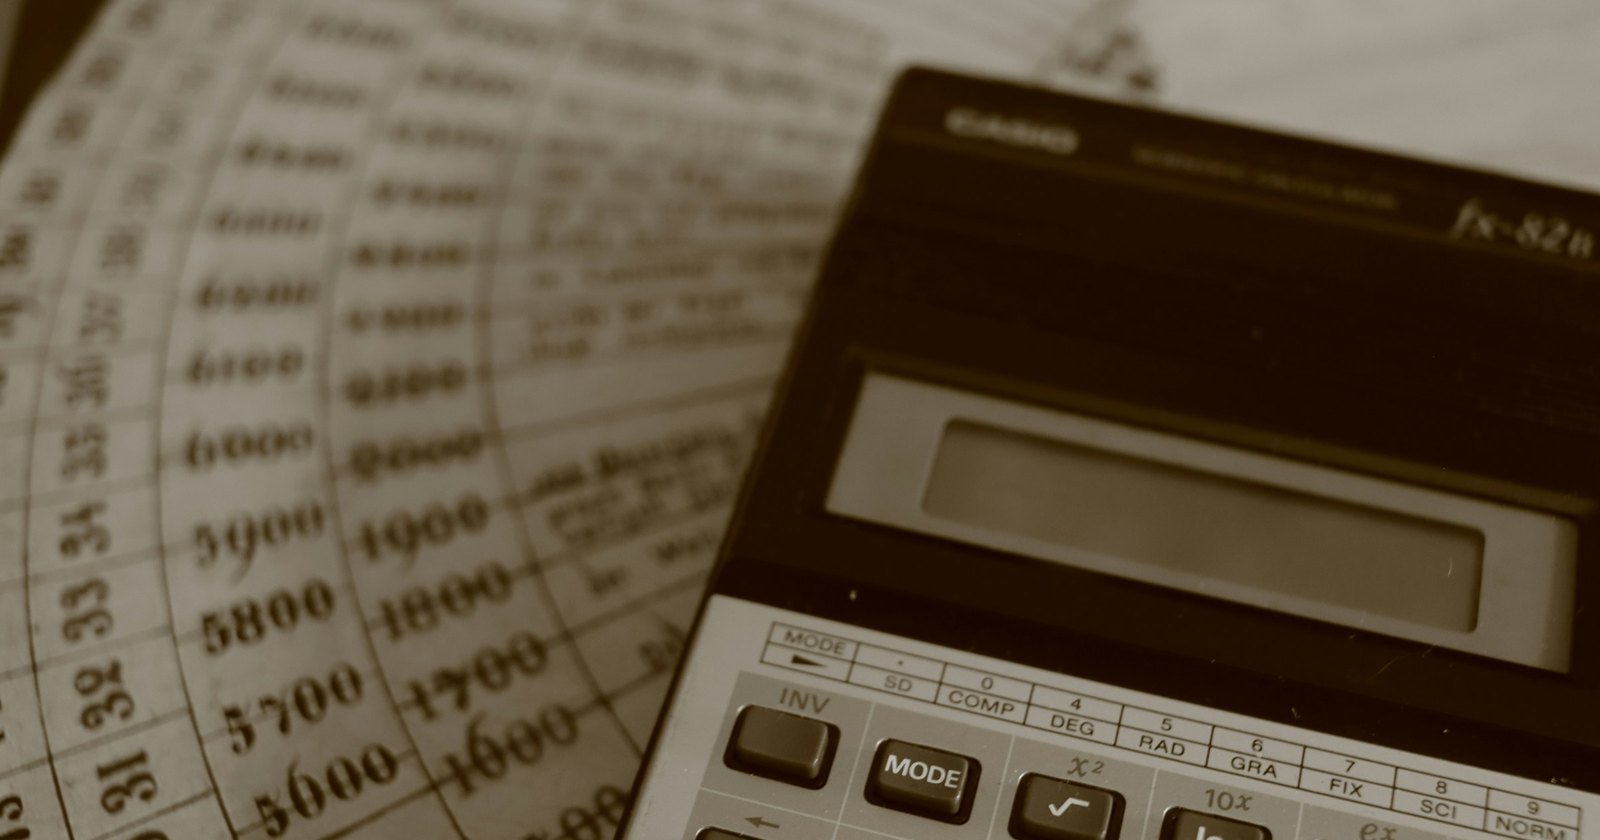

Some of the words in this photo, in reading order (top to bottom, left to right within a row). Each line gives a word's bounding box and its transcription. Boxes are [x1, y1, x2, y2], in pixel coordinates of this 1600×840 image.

[193, 498, 325, 586] 5900
[361, 493, 489, 572] 1900
[59, 576, 114, 646] 33
[200, 576, 336, 658] 5800
[381, 562, 512, 642] 1800
[73, 657, 135, 732] 32
[221, 661, 364, 757] 5700
[407, 630, 550, 722] 1700
[779, 688, 831, 714] INV
[443, 704, 578, 797] 1600
[782, 630, 848, 656] MODE
[980, 676, 994, 691] 0
[1070, 699, 1082, 712] 4
[1161, 718, 1173, 732] 5
[1250, 739, 1264, 753] 6
[1345, 760, 1356, 774] 7
[1435, 780, 1449, 795] 8
[1527, 801, 1540, 816] 9
[883, 675, 914, 694] SD
[948, 690, 1015, 716] COMP
[1049, 715, 1096, 737] DEG
[1139, 735, 1186, 757] RAD
[1230, 756, 1279, 779] GRA
[1329, 778, 1364, 799] FIX
[1419, 799, 1458, 820] SCI
[1495, 815, 1568, 840] NORM
[95, 748, 158, 817] 31
[254, 742, 399, 839] 5600
[884, 754, 961, 789] MODE
